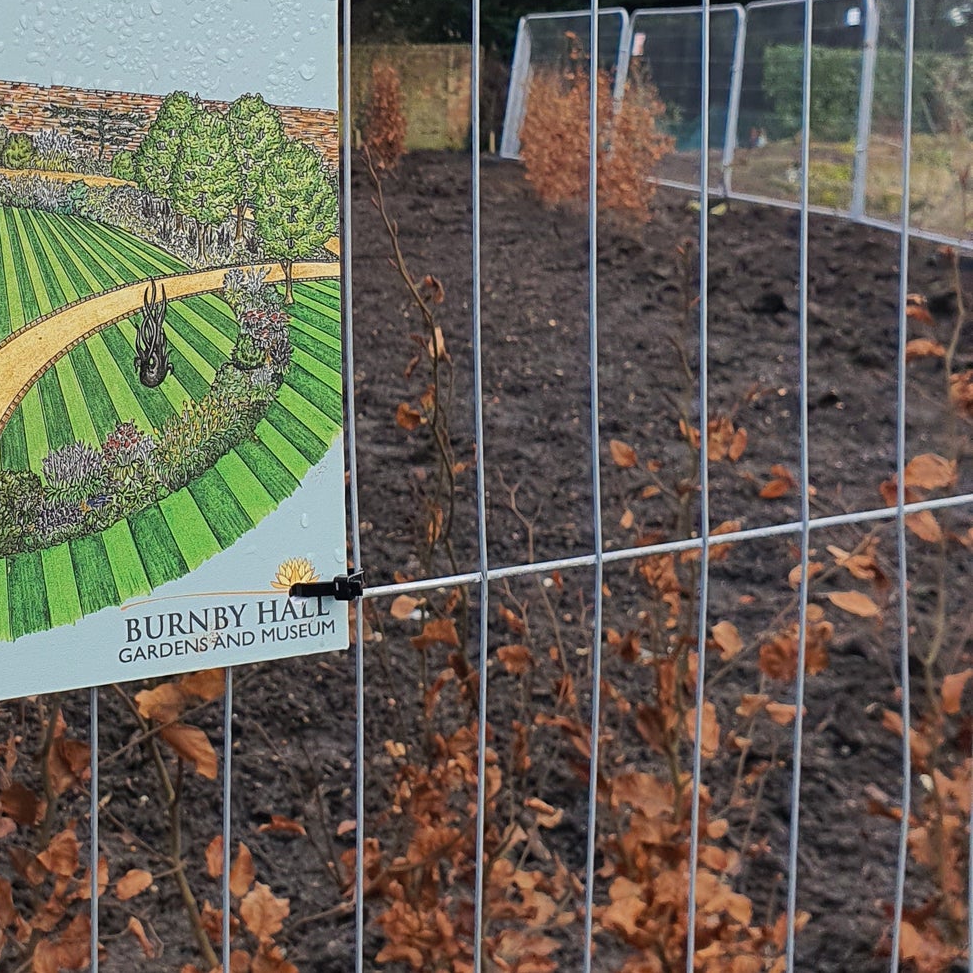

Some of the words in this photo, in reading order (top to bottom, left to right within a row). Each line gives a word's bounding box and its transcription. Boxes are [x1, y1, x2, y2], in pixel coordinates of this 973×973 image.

[119, 637, 208, 663] GARDENS
[213, 631, 255, 650] AND
[262, 620, 335, 643] MUSEUM
[125, 602, 248, 643] BURNBY
[257, 595, 330, 625] HALL
